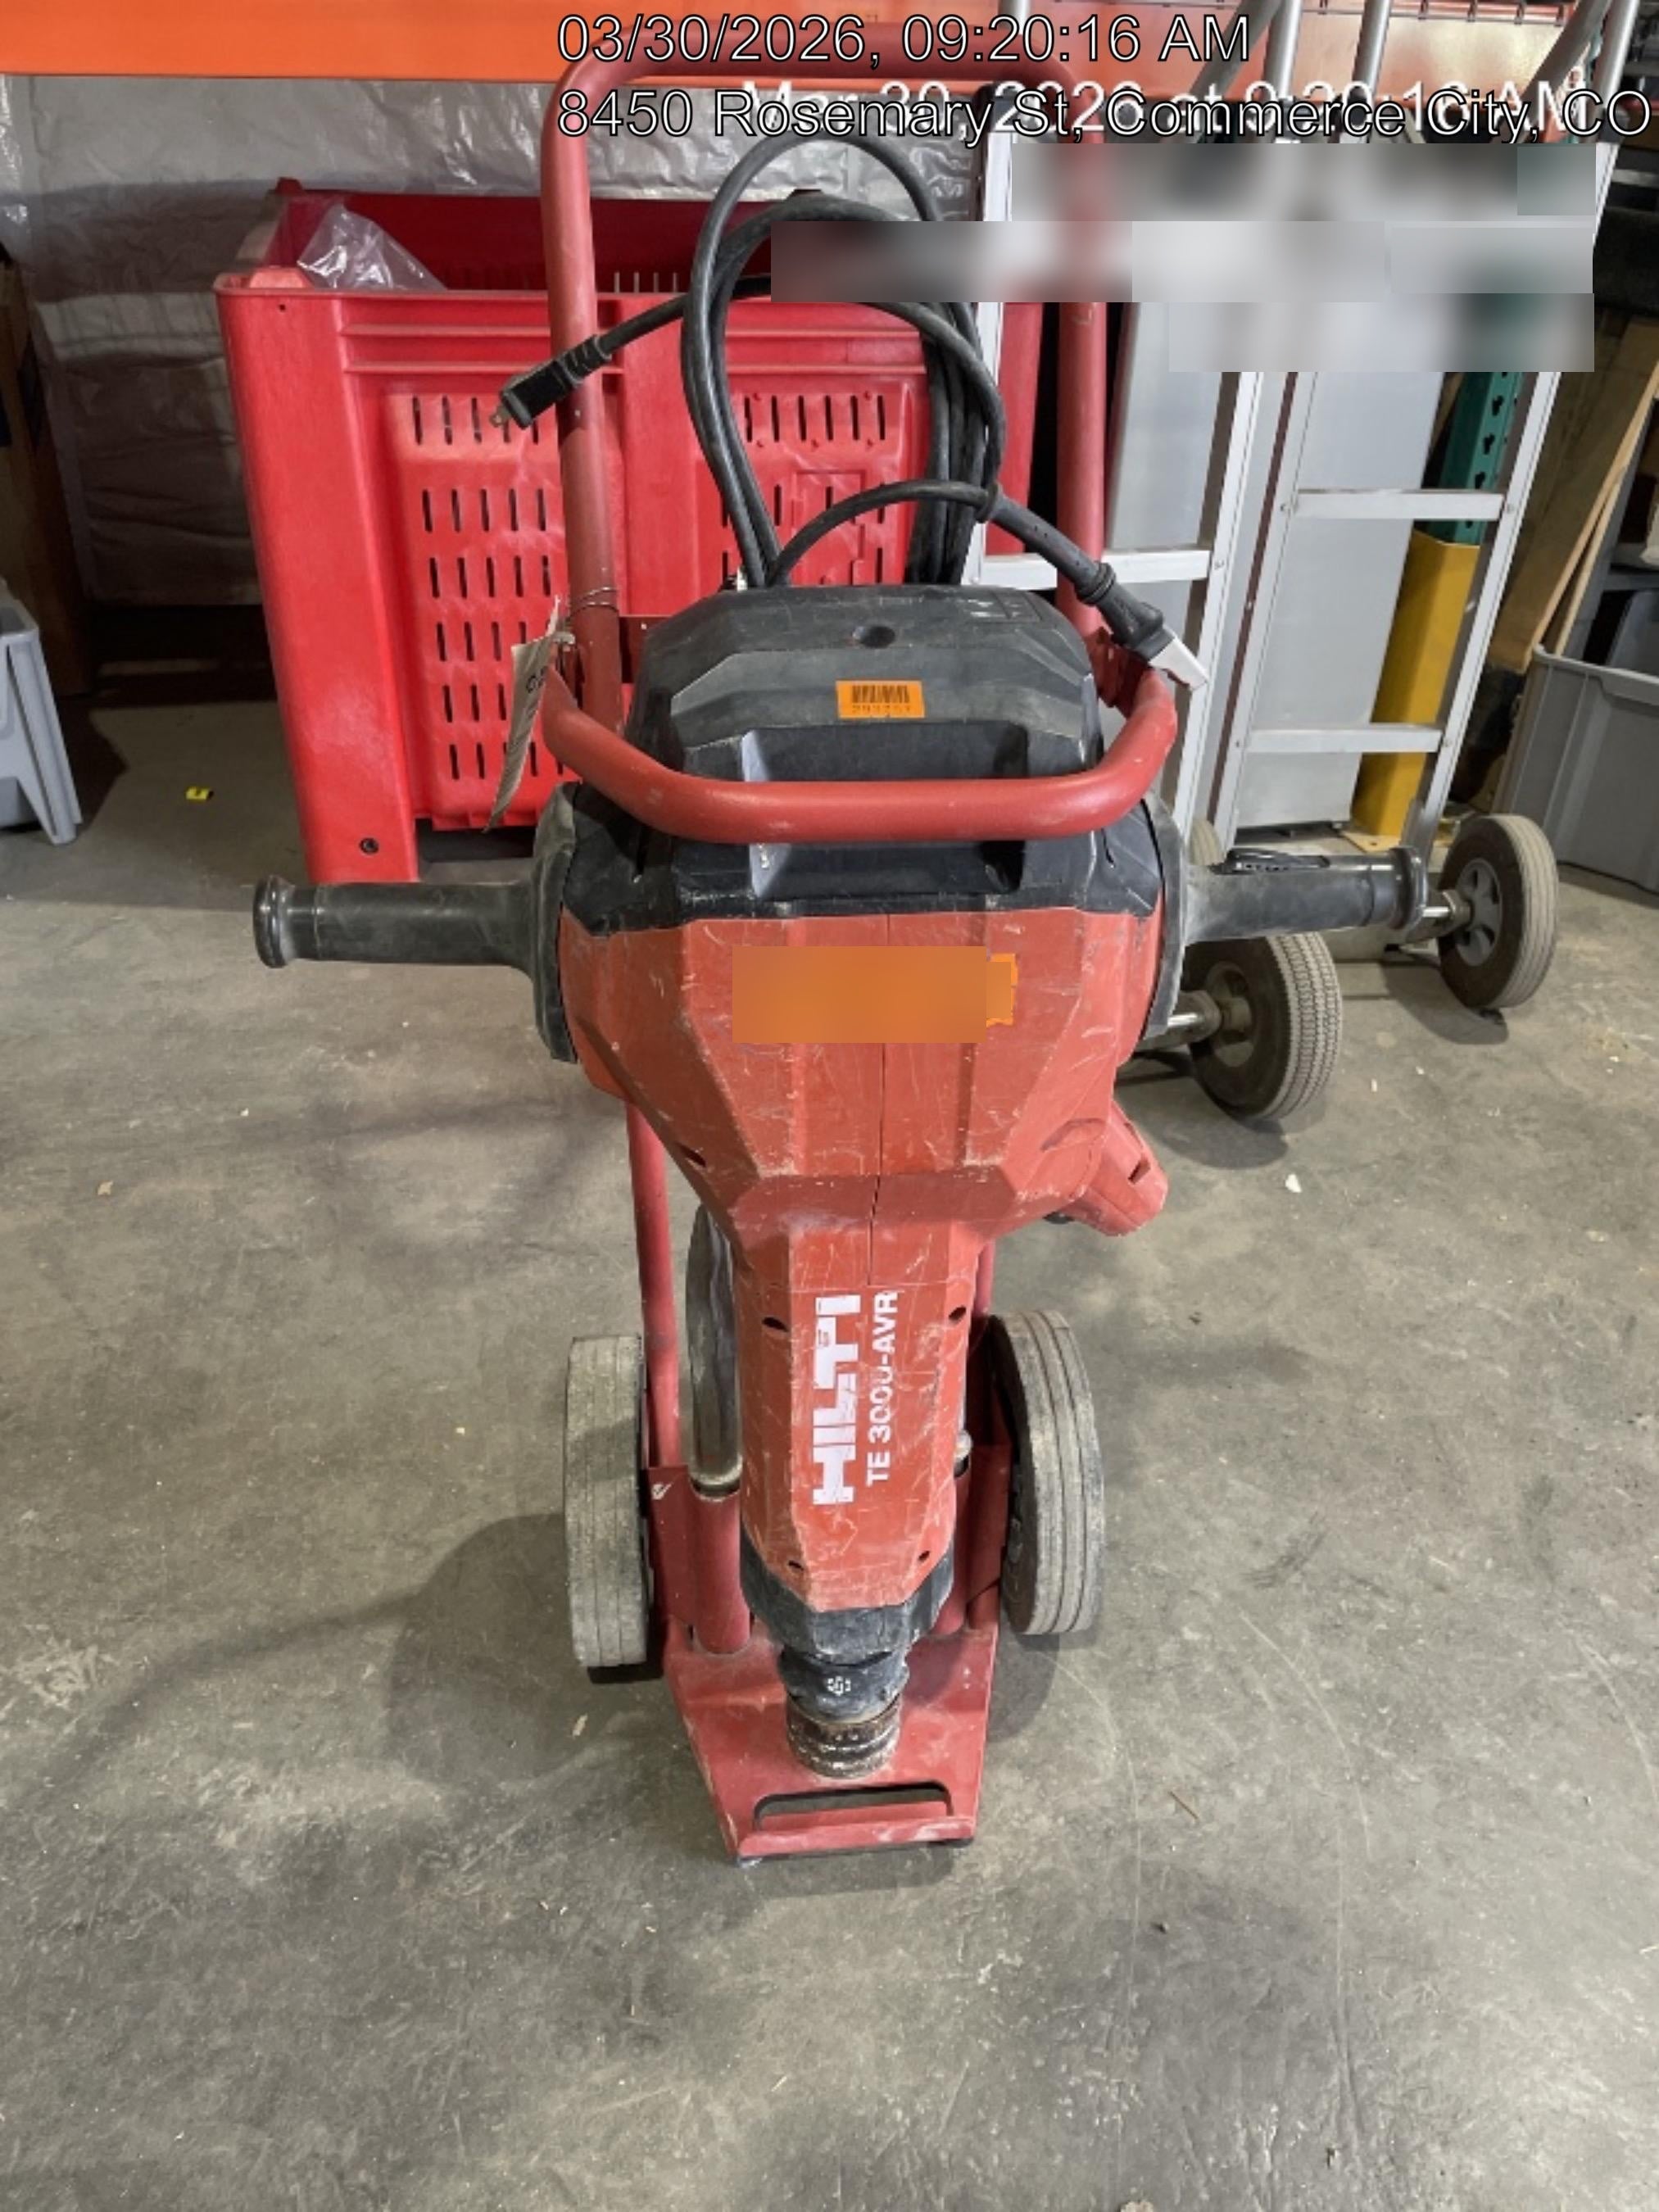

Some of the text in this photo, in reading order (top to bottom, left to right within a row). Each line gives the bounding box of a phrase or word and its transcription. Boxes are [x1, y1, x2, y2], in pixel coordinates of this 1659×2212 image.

[813, 1294, 861, 1505] HILTI
[865, 1290, 899, 1488] TE 3000-AVR
